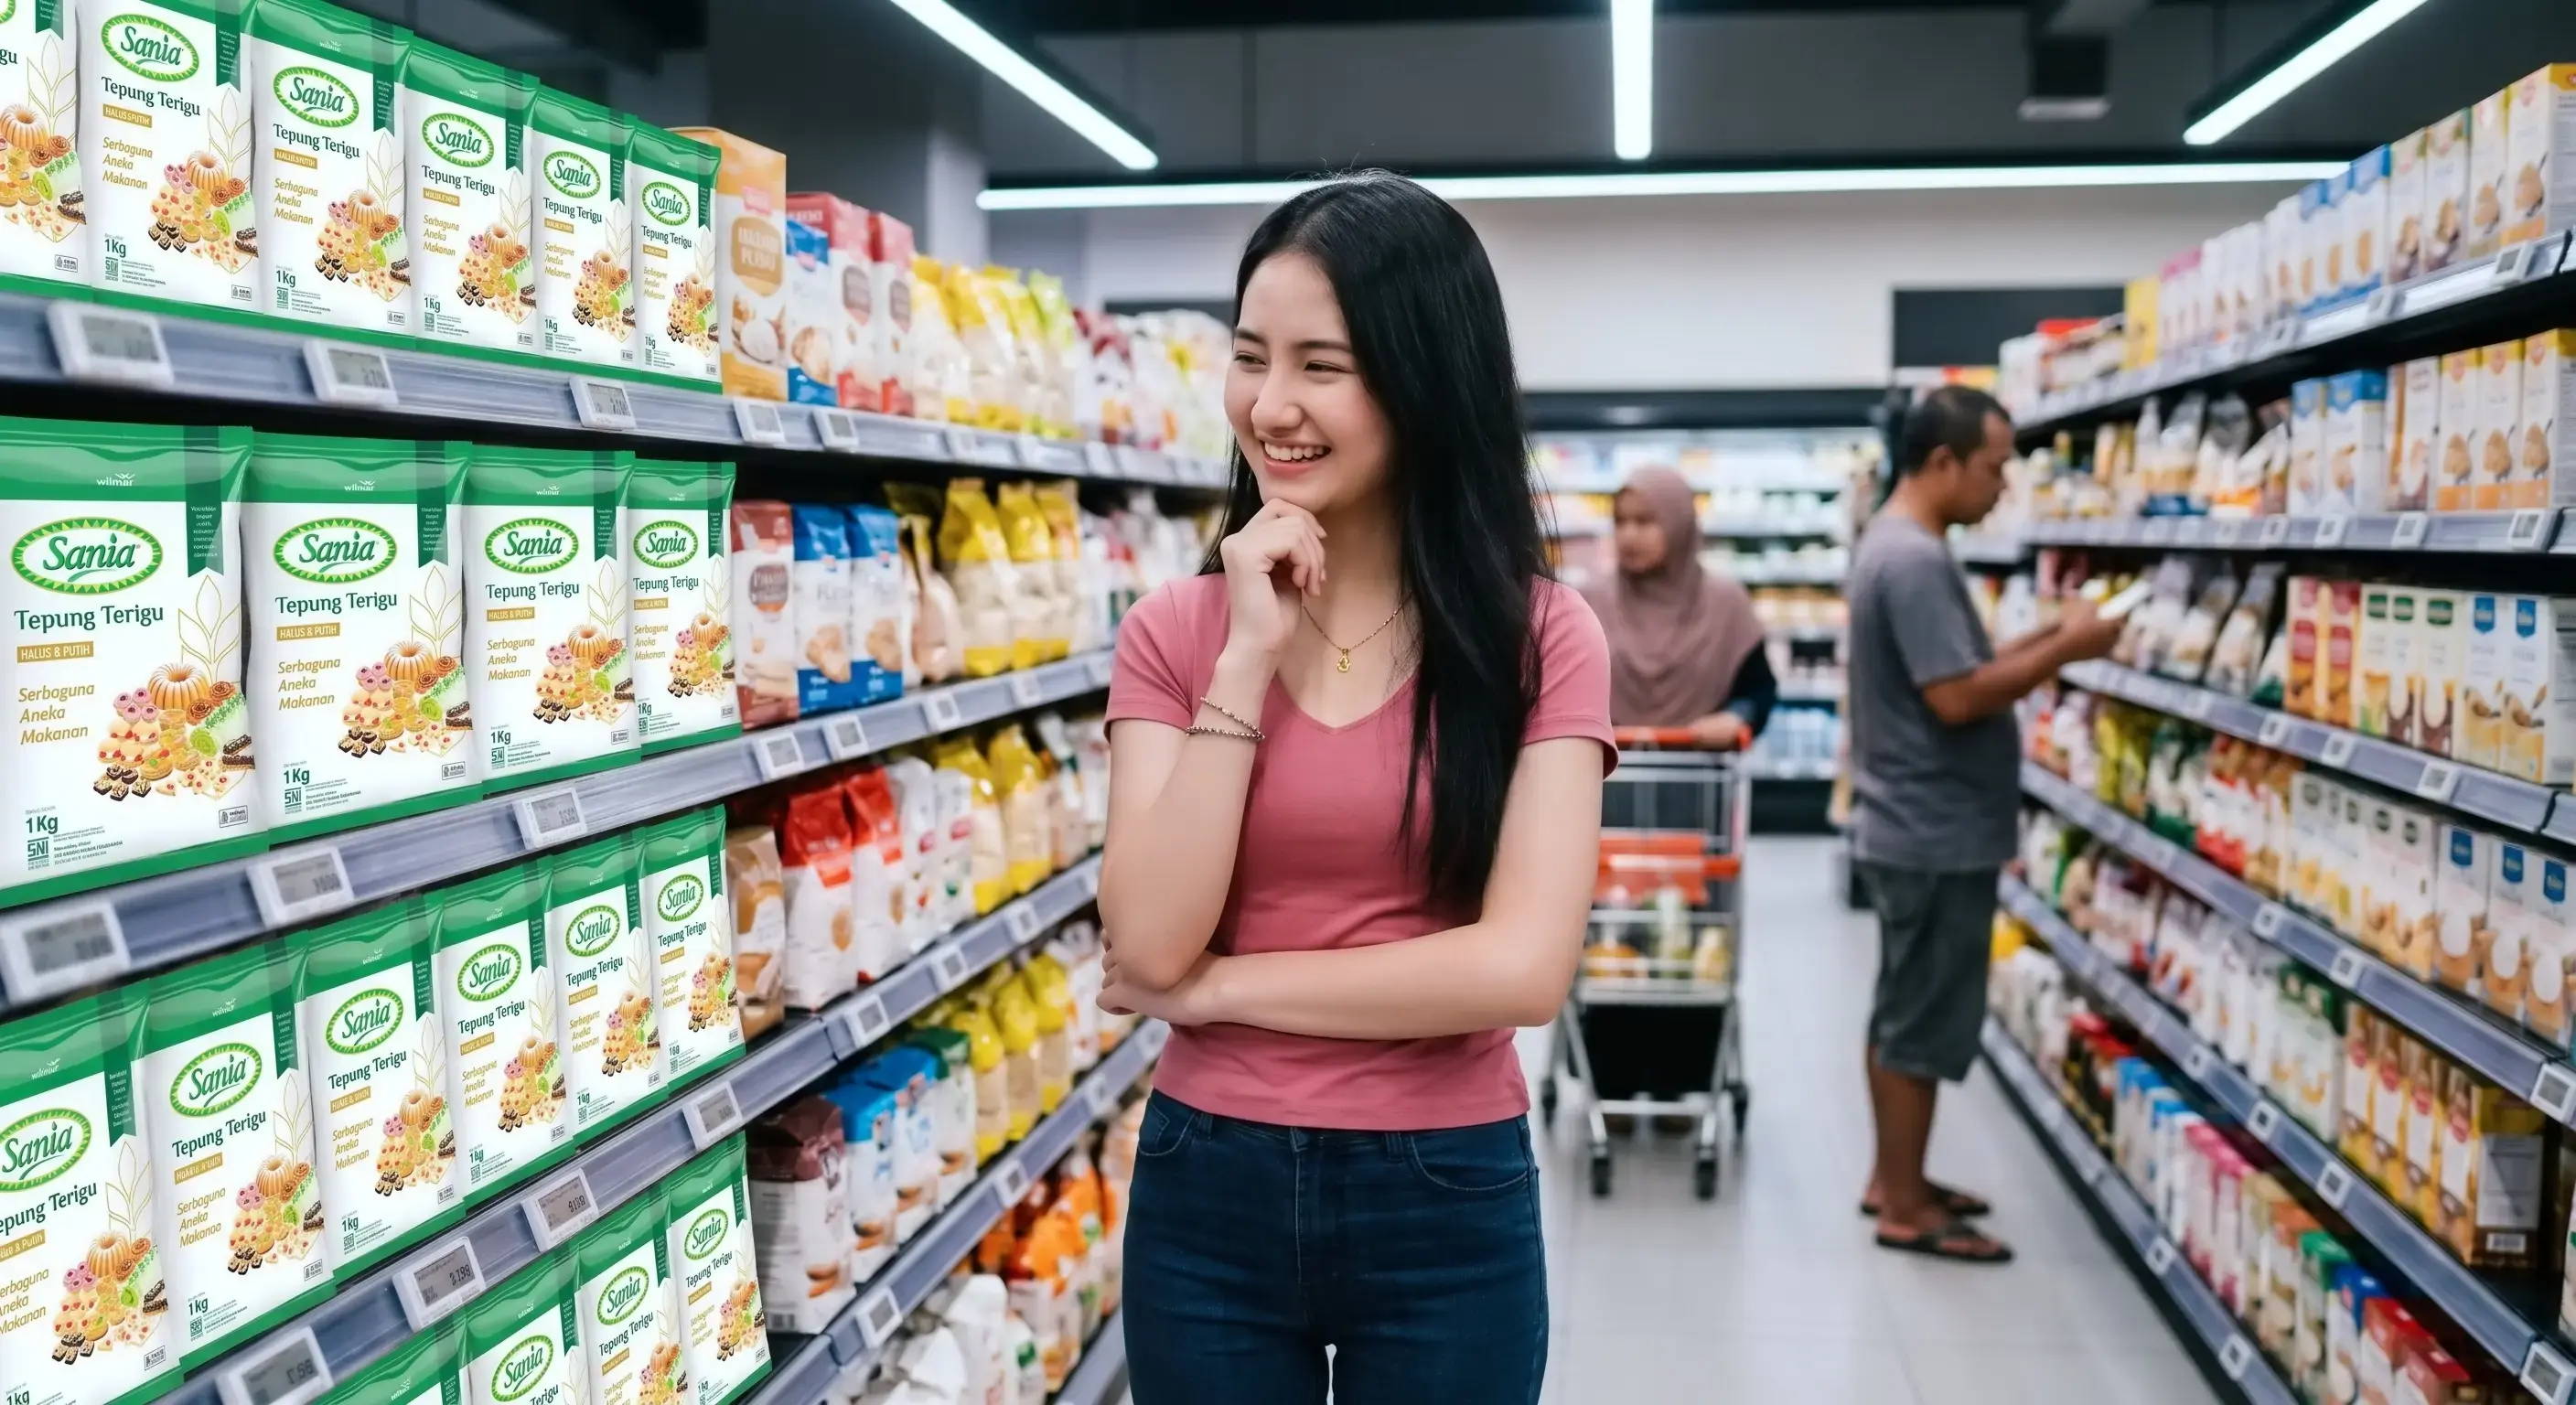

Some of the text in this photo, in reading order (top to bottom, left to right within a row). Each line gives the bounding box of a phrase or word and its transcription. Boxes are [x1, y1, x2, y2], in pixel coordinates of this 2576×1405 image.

[121, 26, 181, 66] Sania
[102, 76, 200, 117] Tepung Terigu
[290, 77, 344, 113] Sania
[274, 123, 360, 158] Tepung Terigu
[435, 122, 482, 156] Sania
[102, 154, 134, 170] Aneka
[553, 162, 591, 188] Sania
[422, 165, 496, 197] Tepung Terigu
[543, 197, 603, 225] Tepung Terigu
[650, 191, 682, 217] Sania
[641, 224, 692, 249] Tepung Terigu
[97, 477, 134, 487] wilmar
[42, 532, 136, 571] Sania
[298, 531, 376, 563] Sania
[503, 529, 564, 557] Sania
[646, 531, 686, 554] Sania
[486, 582, 580, 602] Tepung Terigu
[633, 575, 699, 594] Tepung Terigu
[275, 592, 397, 617] Tepung Terigu
[488, 610, 508, 620] HALUS
[14, 604, 164, 634] Tepung Terigu
[280, 625, 337, 638] HALUS & PUTIH
[21, 645, 90, 660] HALUS & PUTIH
[278, 659, 340, 675] Serbaguna
[278, 677, 316, 693] Aneka
[19, 705, 65, 724] Aneka
[279, 695, 335, 711] Makanan
[27, 841, 49, 857] SNI
[666, 881, 696, 911] Sania
[575, 914, 611, 945] Sania
[658, 920, 707, 948] Tepung Terigu
[469, 954, 511, 989] Sania
[566, 956, 623, 987] Tepung Terigu
[341, 998, 391, 1040] Sania
[457, 1000, 525, 1035] Tepung Terigu
[189, 1053, 247, 1100] Sania
[327, 1050, 407, 1090] Tepung Terigu
[1, 1121, 73, 1173] Sania
[172, 1110, 266, 1158] Tepung Terigu
[0, 1182, 98, 1236] epung Terigu
[179, 1210, 209, 1232] Aneka
[692, 1217, 722, 1244] Sania
[712, 1249, 733, 1272] Terigu
[0, 1269, 49, 1299] erbaguna
[606, 1276, 641, 1314] Sania
[599, 1330, 629, 1357] Tepung
[504, 1345, 543, 1388] Sania
